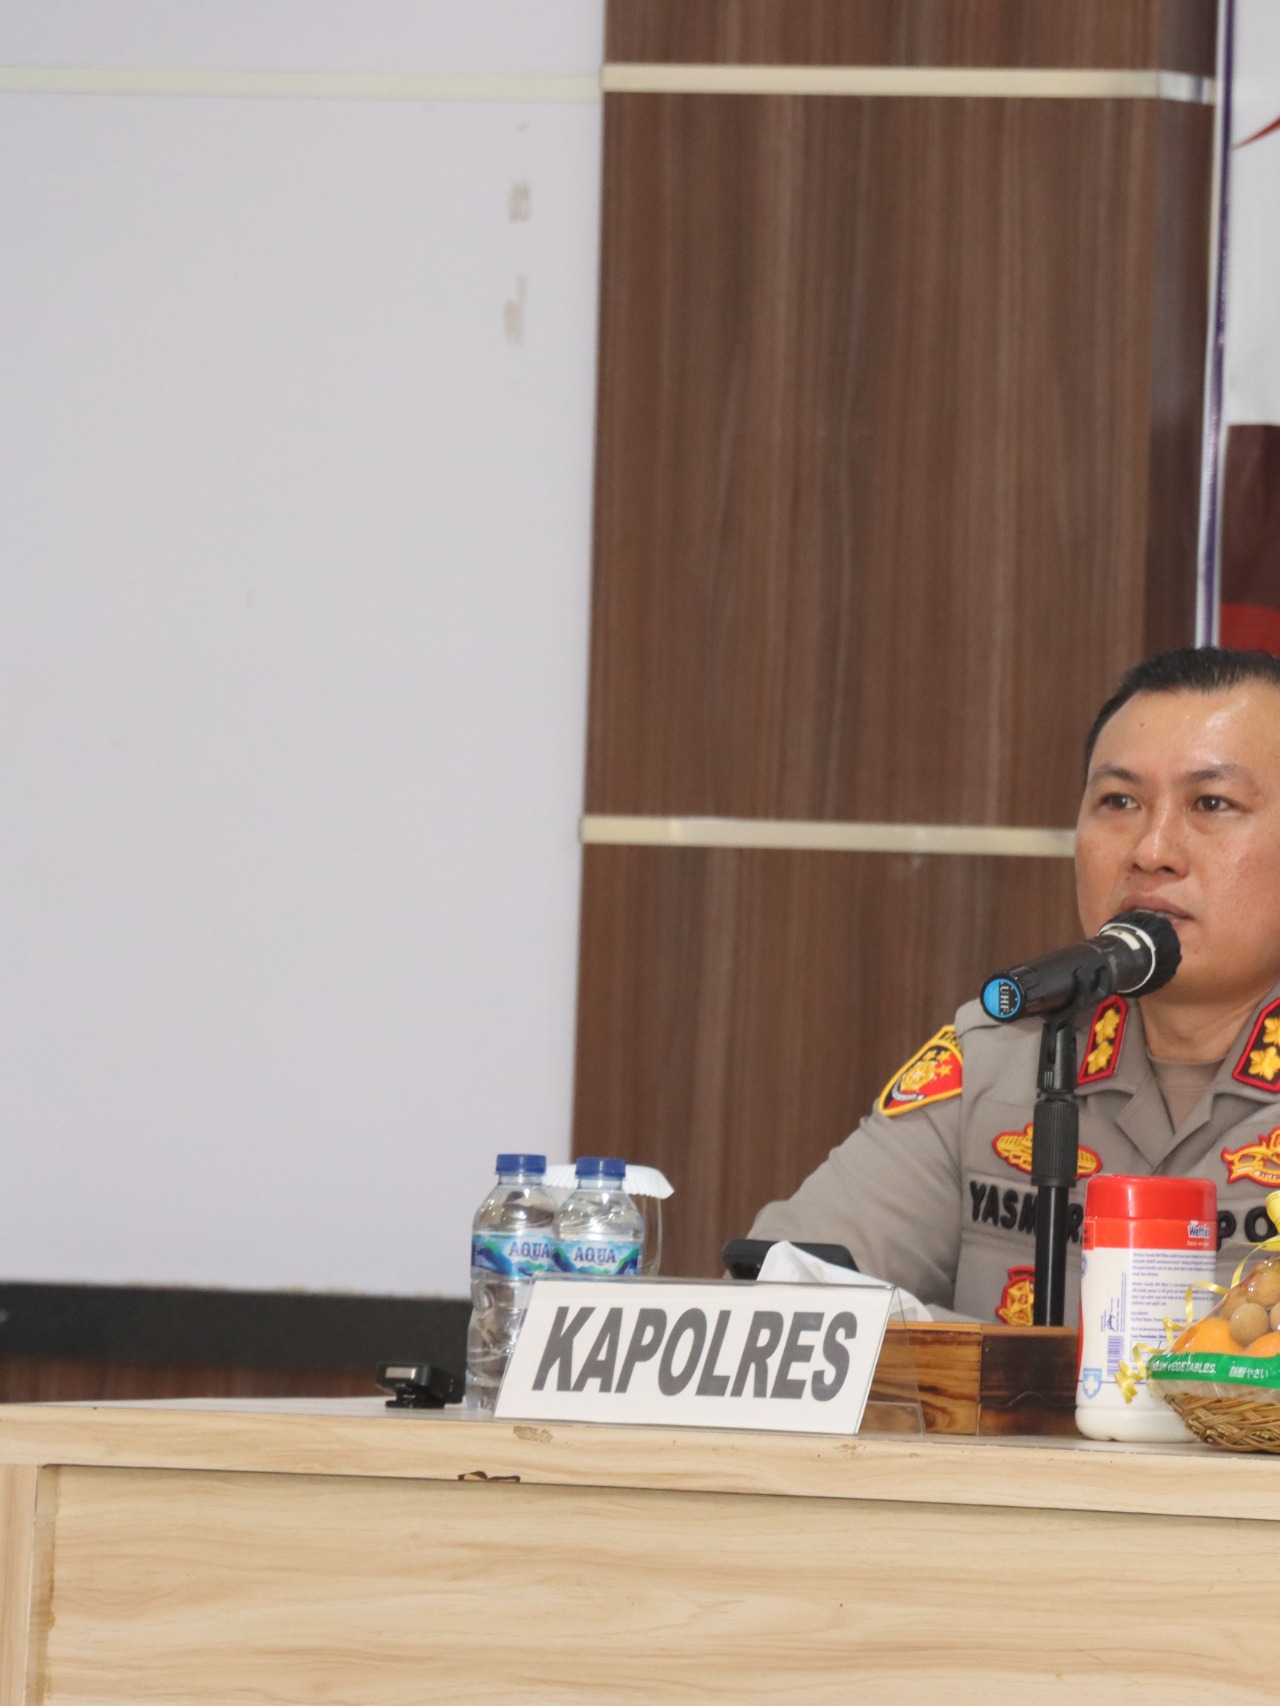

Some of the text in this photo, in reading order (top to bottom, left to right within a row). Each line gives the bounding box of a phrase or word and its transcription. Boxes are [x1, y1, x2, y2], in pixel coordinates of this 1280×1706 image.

[1000, 985, 1010, 1013] UHF
[508, 1242, 551, 1260] AQUA
[574, 1246, 617, 1265] AQUA
[532, 1306, 857, 1402] KAPOLRES
